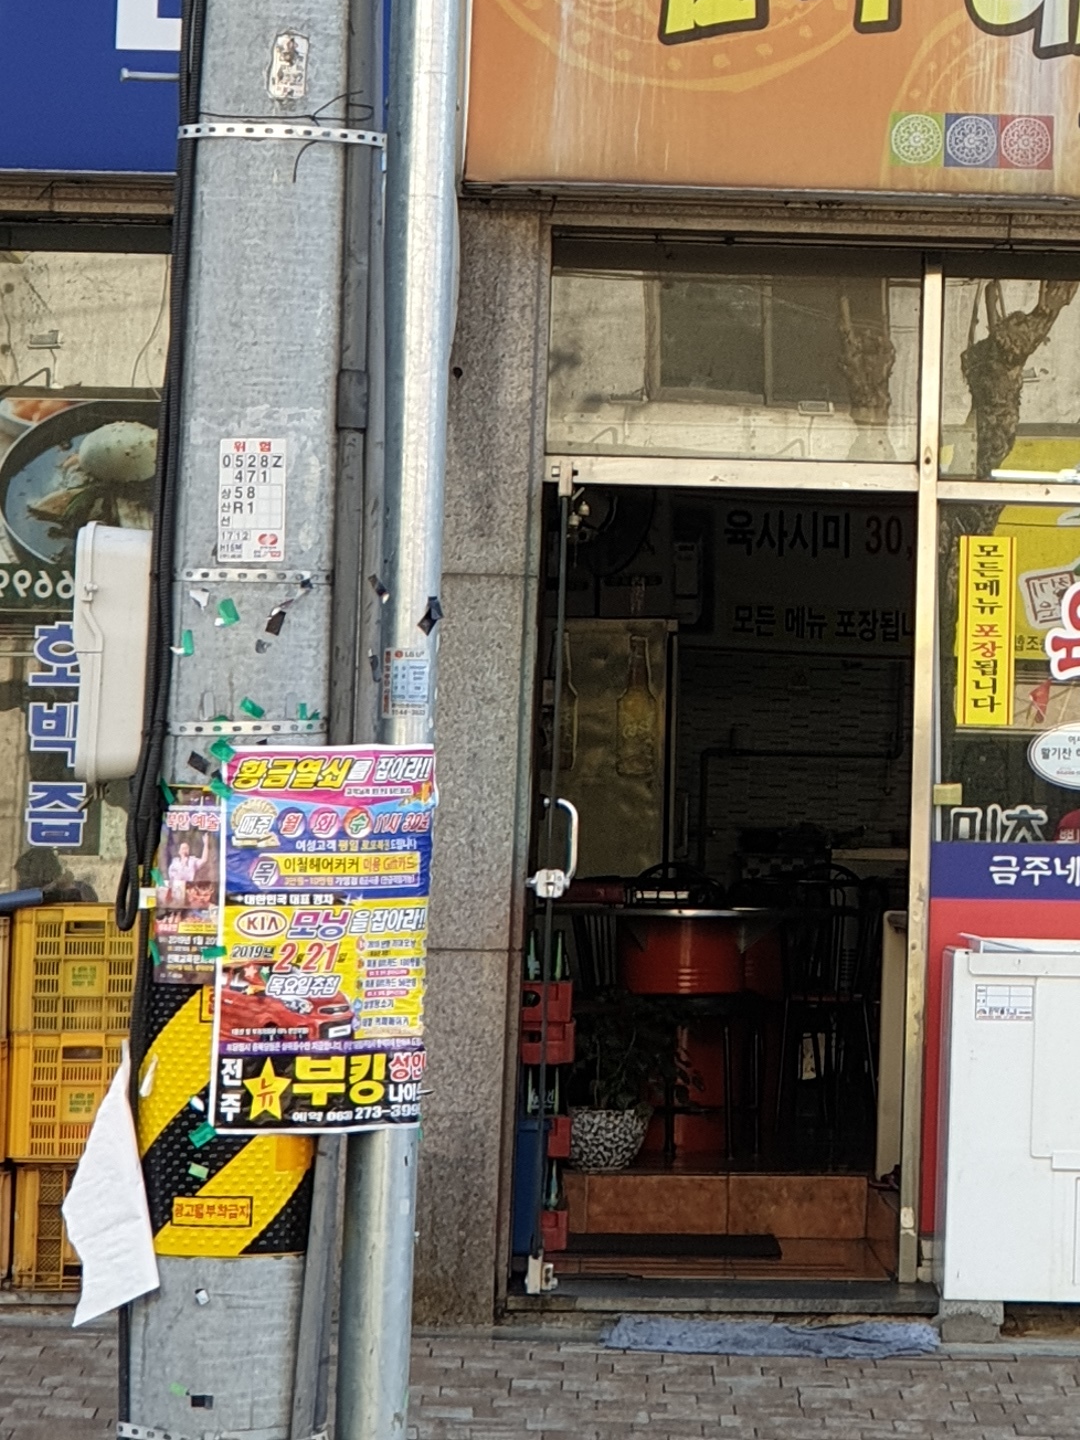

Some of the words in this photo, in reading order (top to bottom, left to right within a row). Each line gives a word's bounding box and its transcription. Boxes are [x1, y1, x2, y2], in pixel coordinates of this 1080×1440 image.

[222, 455, 282, 468] 0528Z
[234, 470, 267, 483] 471
[234, 486, 255, 499] 58
[233, 501, 254, 514] R1
[723, 509, 851, 558] 육사시미
[732, 606, 776, 638] 모든
[785, 606, 827, 639] 메뉴
[1041, 748, 1072, 760] 활기찬
[238, 813, 273, 838] 매주
[313, 812, 337, 835] 화
[350, 812, 369, 835] 수
[246, 920, 279, 932] KIA
[293, 1053, 387, 1106] 부킹
